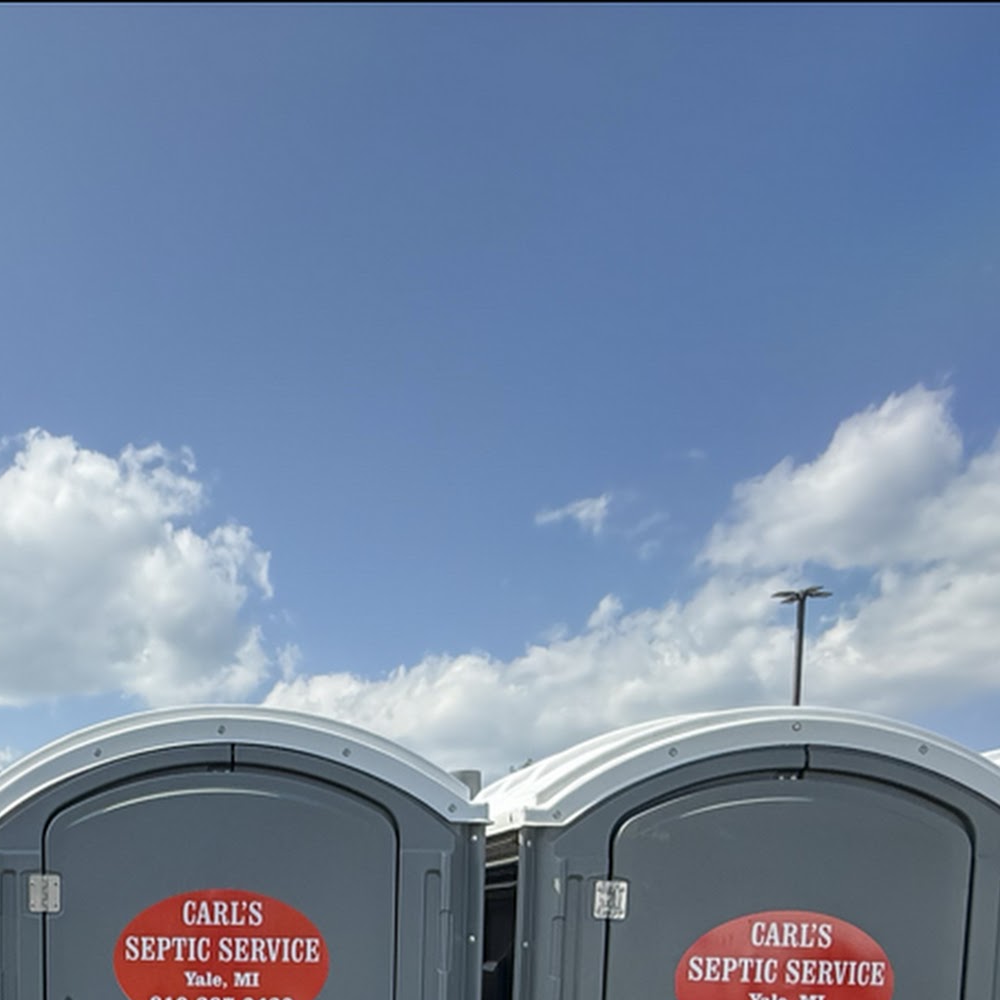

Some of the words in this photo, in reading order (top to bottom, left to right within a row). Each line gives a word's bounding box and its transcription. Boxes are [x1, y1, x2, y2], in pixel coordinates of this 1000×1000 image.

[182, 900, 263, 926] CARL'S
[751, 921, 833, 949] CARL'S
[125, 935, 211, 962] SEPTIC
[218, 936, 321, 964] SERVICE
[183, 970, 228, 989] Yale,
[233, 971, 260, 988] MI
[687, 954, 779, 985] SEPTIC
[784, 958, 886, 987] SERVICE
